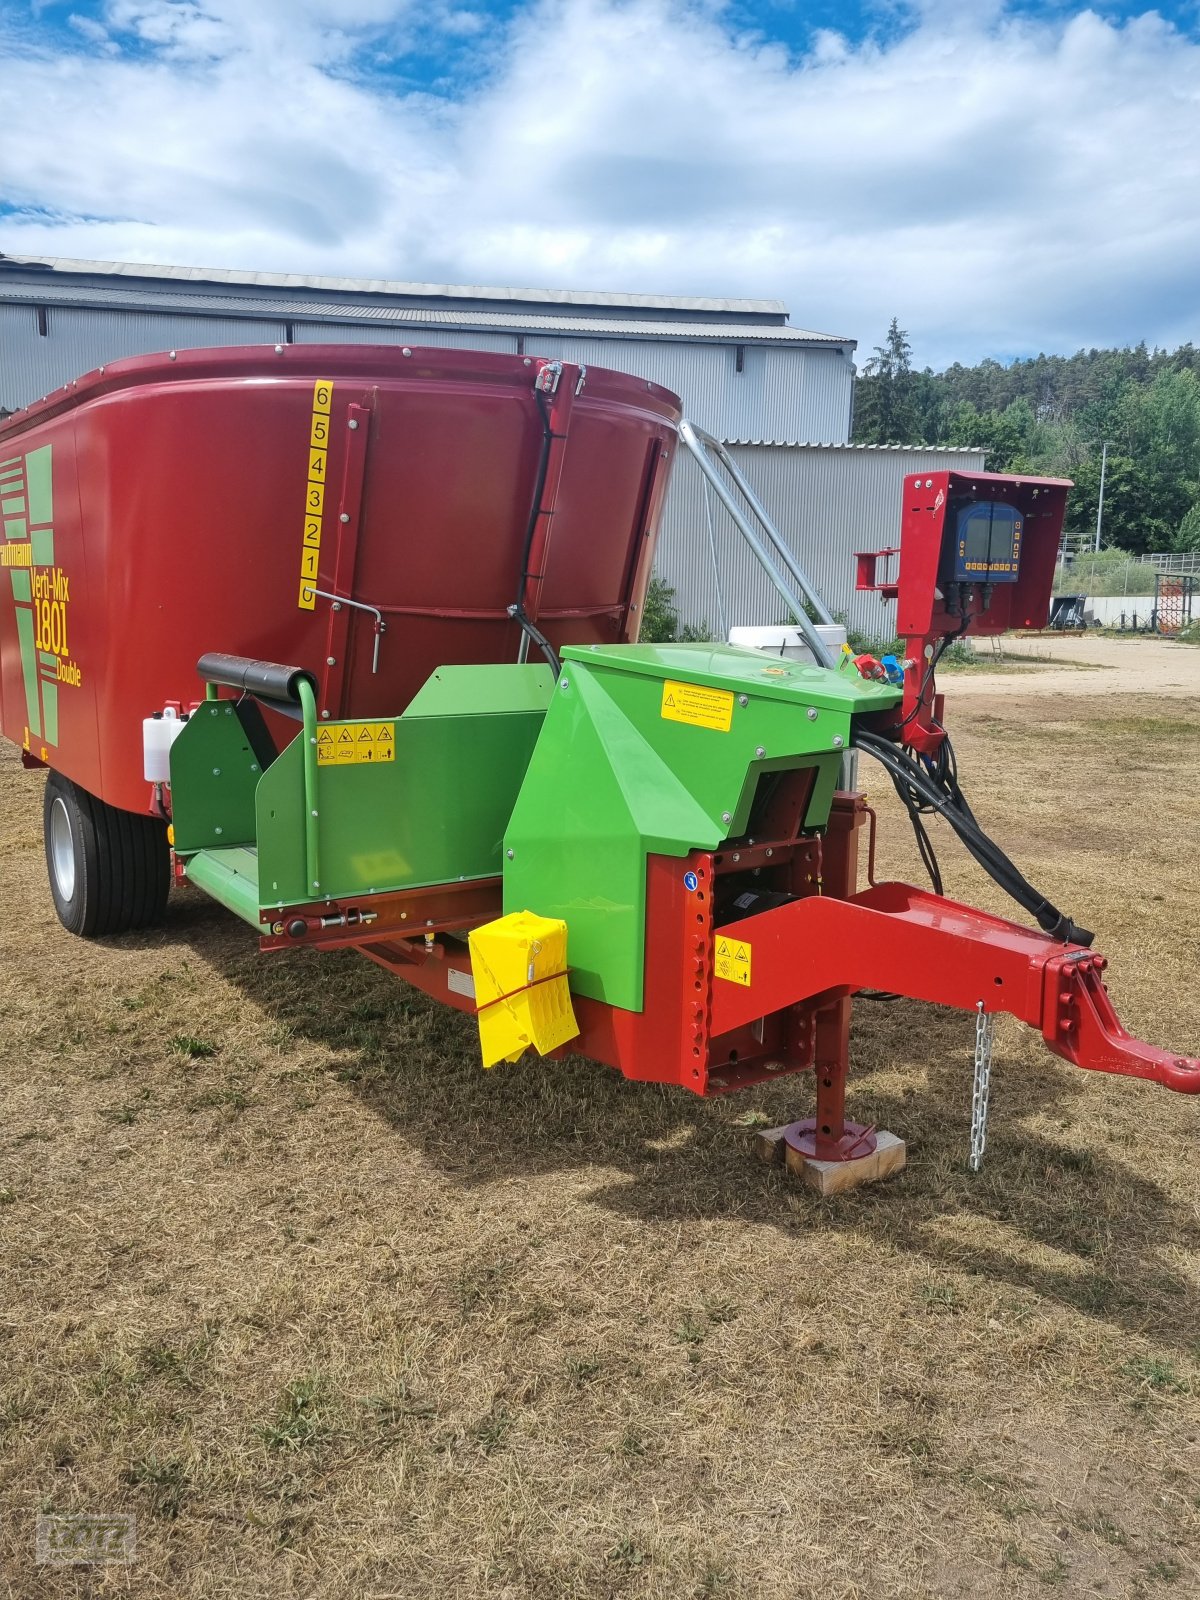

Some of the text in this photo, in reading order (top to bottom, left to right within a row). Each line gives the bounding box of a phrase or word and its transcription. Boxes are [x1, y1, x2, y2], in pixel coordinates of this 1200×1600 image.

[317, 387, 329, 405] 6
[314, 422, 326, 440] 5
[311, 457, 324, 475] 4
[309, 490, 320, 507] 3
[306, 523, 318, 541] 2
[307, 555, 314, 572] 1
[30, 566, 70, 602] Verti-Mix
[302, 585, 313, 602] 0
[35, 598, 69, 657] 1801
[56, 656, 81, 688] Double
